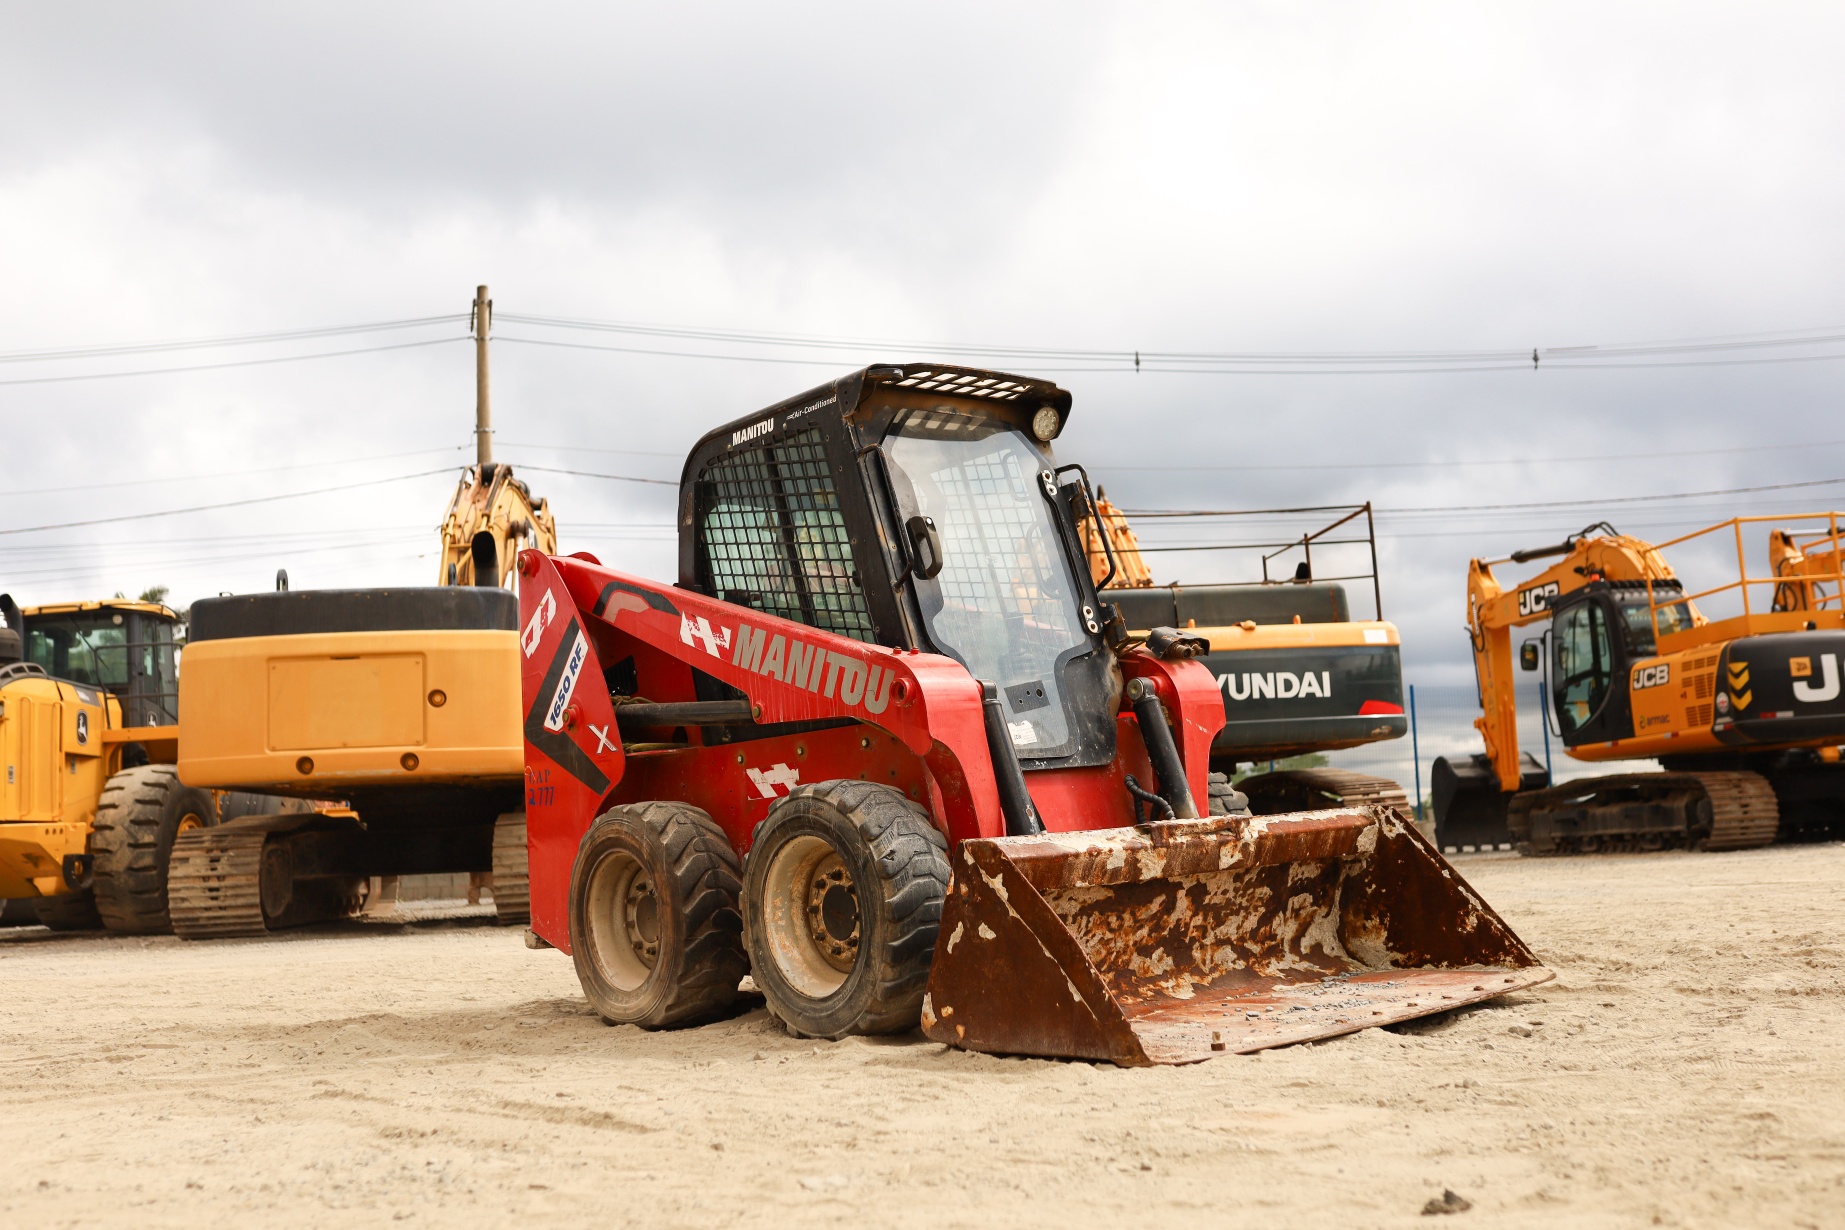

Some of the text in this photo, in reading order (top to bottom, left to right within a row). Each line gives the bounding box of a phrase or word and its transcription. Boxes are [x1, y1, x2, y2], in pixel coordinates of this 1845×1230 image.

[732, 418, 774, 446] MANITOU
[550, 642, 582, 726] 1650 RF
[732, 623, 896, 715] MANITOU
[1633, 663, 1669, 690] JCB
[587, 723, 619, 755] X
